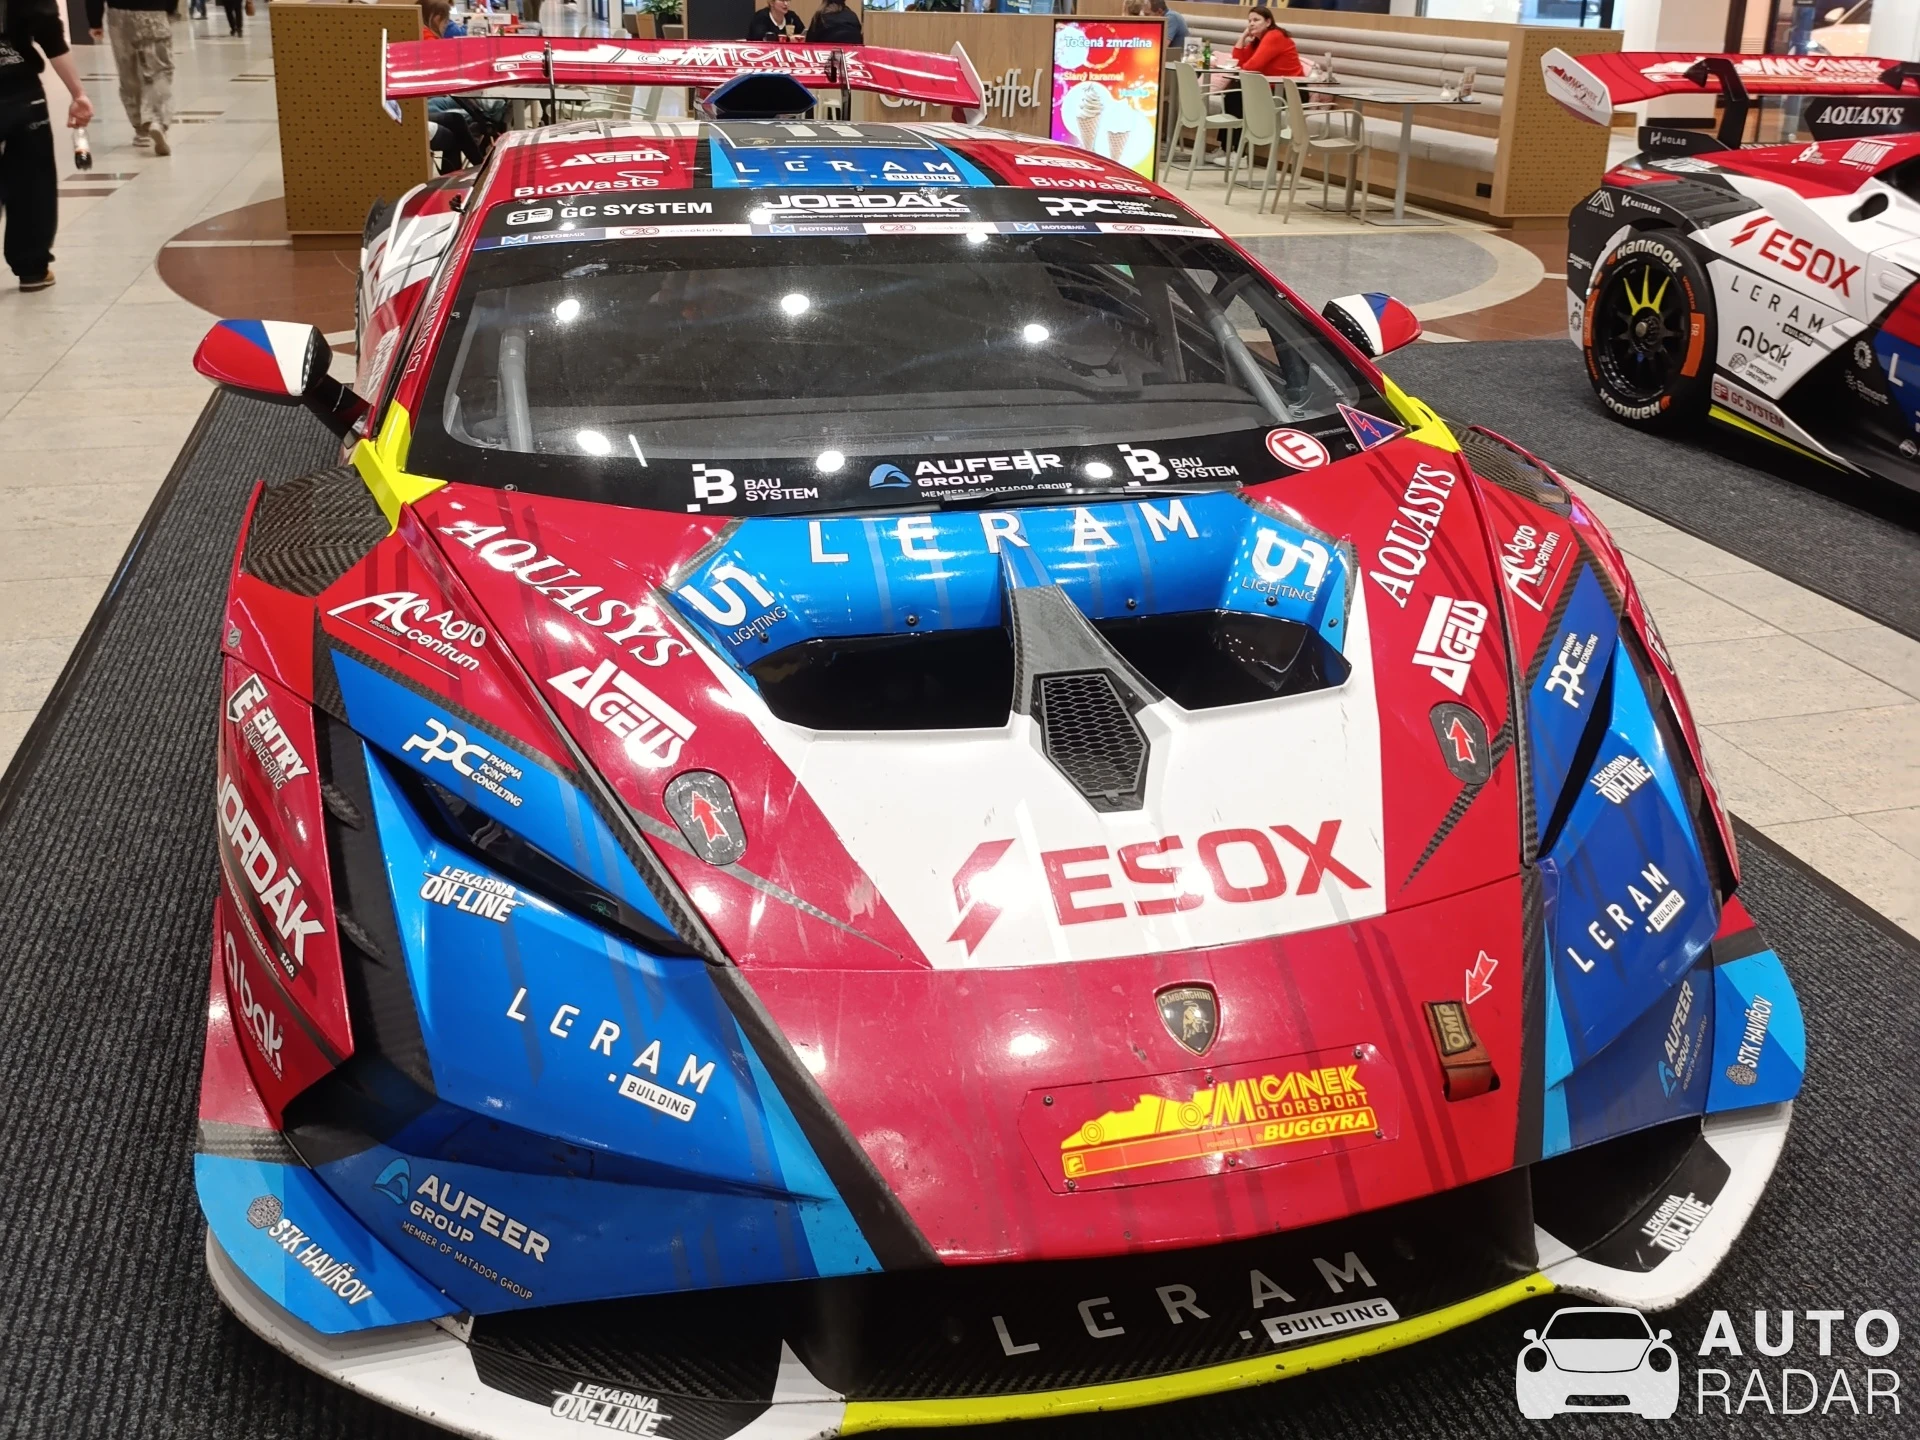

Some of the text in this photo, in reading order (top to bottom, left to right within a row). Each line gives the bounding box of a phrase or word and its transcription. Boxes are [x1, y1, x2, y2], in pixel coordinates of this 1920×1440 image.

[1064, 36, 1152, 48] Točená zmrzlina
[1816, 106, 1904, 125] AQUASYS
[735, 160, 956, 173] LERAM
[514, 176, 659, 198] BioWaste
[1029, 177, 1152, 194] BioWaste
[560, 202, 713, 218] GC SYSTEM
[1122, 210, 1178, 219] CONSULTING
[1630, 200, 1661, 215] KAITRADE
[532, 232, 586, 241] MOTORMIX
[1758, 228, 1861, 298] ESOX
[1730, 275, 1825, 333] LERAM
[1784, 325, 1813, 345] BUILDING
[1731, 392, 1785, 429] GC SYSTEM
[915, 454, 1064, 476] AUFEER
[1169, 456, 1203, 469] BAU
[1274, 434, 1322, 465] E
[743, 478, 781, 490] BAU
[917, 474, 994, 487] GROUP
[1175, 466, 1239, 479] SYSTEM
[745, 487, 818, 502] SYSTEM
[808, 499, 1200, 563] LERAM
[1369, 462, 1456, 608] AQUASYS
[1509, 525, 1537, 558] Agro
[1535, 531, 1560, 567] centrum
[437, 525, 692, 667] AQUASYS
[1241, 576, 1316, 602] LIGHTING
[424, 610, 487, 648] Agro
[728, 606, 787, 647] LIGHTING
[1563, 632, 1578, 655] PHARMA
[407, 629, 480, 671] centrum
[1572, 642, 1583, 659] POINT
[1581, 633, 1599, 665] CONSULTING
[1544, 651, 1588, 709] PPC
[242, 720, 288, 790] ENGINEERING
[253, 706, 310, 781] ENTRY
[402, 718, 491, 777] PPC
[479, 762, 508, 782] POINT
[487, 754, 523, 781] PHARMA
[1590, 754, 1632, 787] LEKARNA
[1602, 760, 1653, 804] ON-LINE
[471, 772, 523, 808] CONSULTING
[441, 866, 517, 898] LEKARNA
[1040, 818, 1373, 927] ESOX
[419, 876, 517, 923] ON-LINE
[1653, 894, 1682, 927] BUILDING
[1567, 862, 1669, 973] LERAM
[279, 951, 296, 977] s.r.o.
[1159, 990, 1212, 1007] LAMBORGHINI
[1439, 1004, 1465, 1048] OMP
[1664, 980, 1694, 1064] AUFEER
[1737, 994, 1773, 1068] STK HAVÍŘOV
[506, 987, 717, 1094] LERAM
[1674, 1034, 1690, 1078] GROUP
[626, 1081, 691, 1116] BUILDING
[1264, 1112, 1370, 1141] BUGGYRA
[409, 1200, 475, 1243] GROUP
[416, 1175, 551, 1263] AUFEER
[1641, 1194, 1685, 1237] LEKARNA
[1657, 1198, 1713, 1252] ON-LINE
[268, 1218, 373, 1304] STK HAVÍŘOV
[402, 1222, 533, 1300] MEMBER OF MATADOR GROUP
[992, 1251, 1378, 1356] LERAM
[1277, 1303, 1389, 1336] BUILDING
[571, 1381, 659, 1413] LEKARNA
[550, 1393, 661, 1438] ON-LINE
